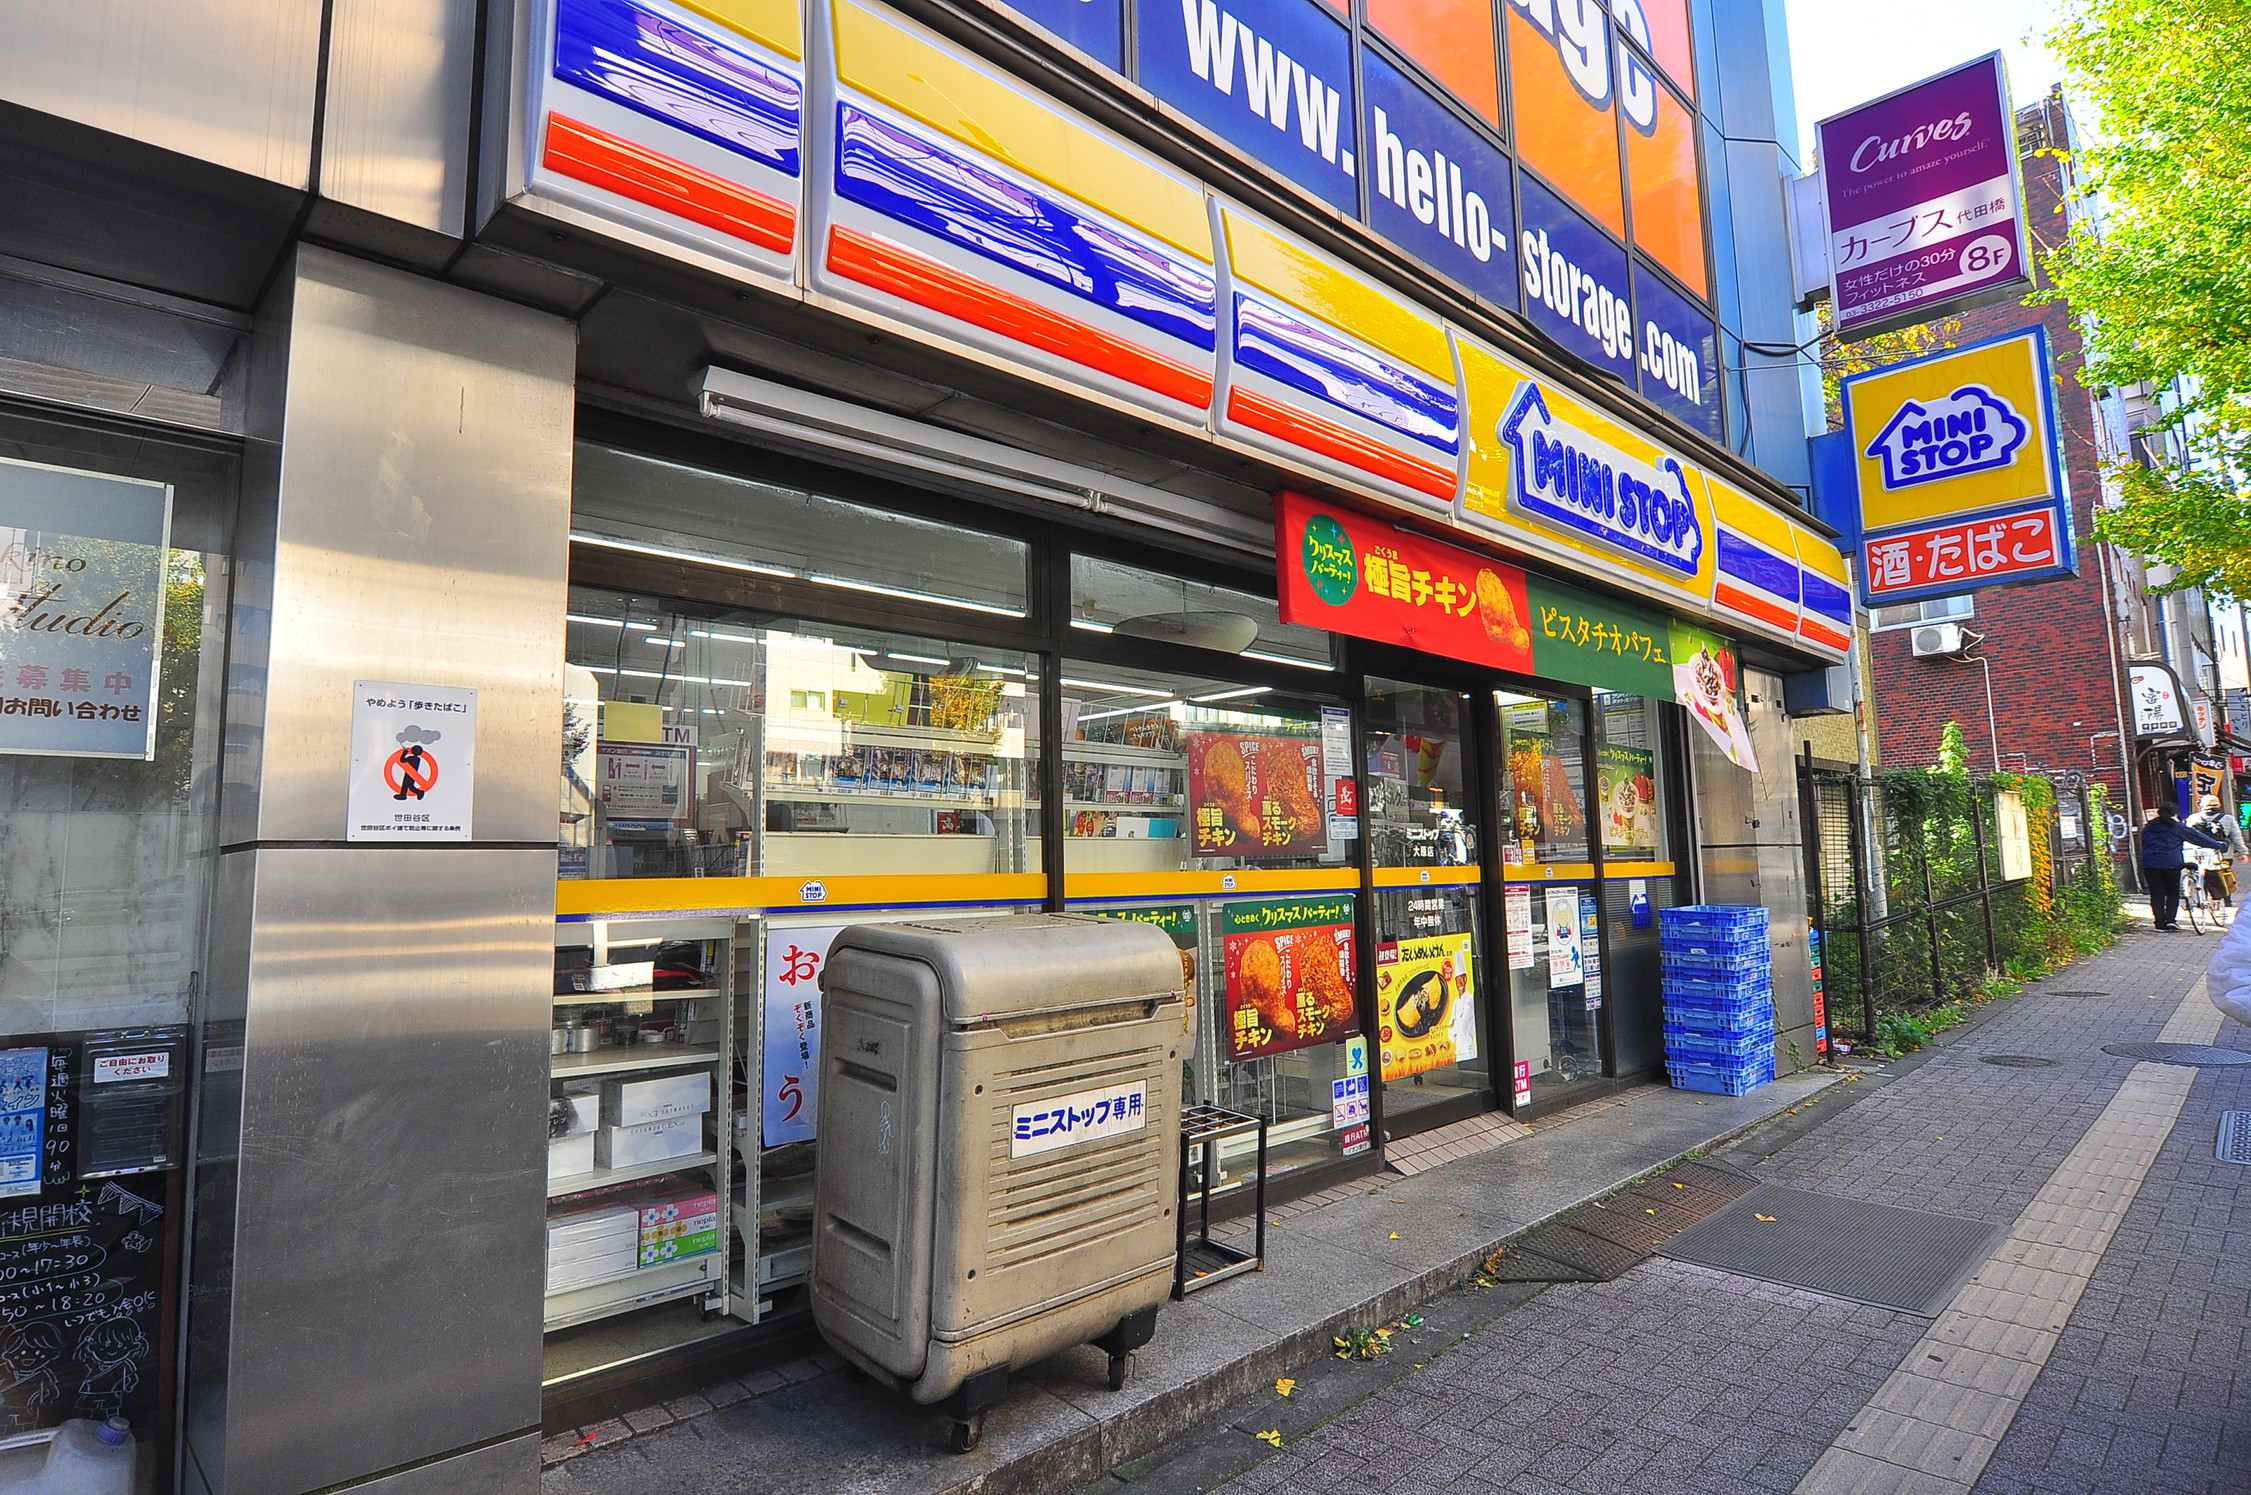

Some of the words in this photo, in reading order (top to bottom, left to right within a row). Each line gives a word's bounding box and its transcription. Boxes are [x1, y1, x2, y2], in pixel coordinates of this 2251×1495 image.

[1506, 0, 1657, 136] ge
[1850, 111, 1973, 173] Curves
[1842, 183, 1861, 199] The
[1863, 174, 1895, 195] power
[1896, 169, 1908, 180] to
[1910, 158, 1942, 176] amaze
[1181, 0, 1355, 178] www.
[1374, 104, 1507, 262] hello-
[1522, 228, 1632, 360] storage
[1641, 320, 1700, 406] .com
[1840, 208, 1954, 266] カーブス
[1956, 196, 2006, 225] 代田橋
[1843, 246, 1957, 293] 女性だけの30分
[1967, 245, 2006, 273] 8F
[1845, 272, 1927, 305] フィットネス
[1845, 287, 1925, 319] 03-3322-5150
[1901, 406, 1987, 449] MINI
[1900, 433, 1994, 476] STOP
[1532, 428, 1615, 520] MINI
[1617, 471, 1692, 551] STOP
[1308, 534, 1354, 568] クリスマス
[1871, 518, 2052, 588] 酒・たばこ
[1363, 552, 1478, 618] 極旨チキン
[1540, 605, 1668, 665] ピスタチオパフェ
[366, 697, 467, 713] やめよう「歩きたばこ」
[2196, 705, 2207, 730] キッチン
[1250, 755, 1258, 796] こだわり
[394, 814, 430, 823] 世田谷区
[1196, 807, 1225, 828] 極旨
[1262, 815, 1297, 832] スモーク
[1198, 827, 1237, 848] チキン
[1262, 831, 1292, 848] チキン
[1406, 827, 1441, 841] ミニストップ
[1412, 845, 1435, 858] 大原店
[1407, 898, 1445, 912] 24時間営業
[1413, 914, 1442, 929] 年中無休
[1274, 934, 1294, 950] SPICE
[803, 1000, 816, 1031] 新商品
[1296, 1004, 1331, 1024] スモーク
[1234, 1028, 1273, 1051] チキン
[1297, 1022, 1325, 1040] チキン
[99, 1055, 165, 1068] ご自由にお取り
[114, 1065, 152, 1076] ください
[1014, 1092, 1142, 1140] ミニストップ専用
